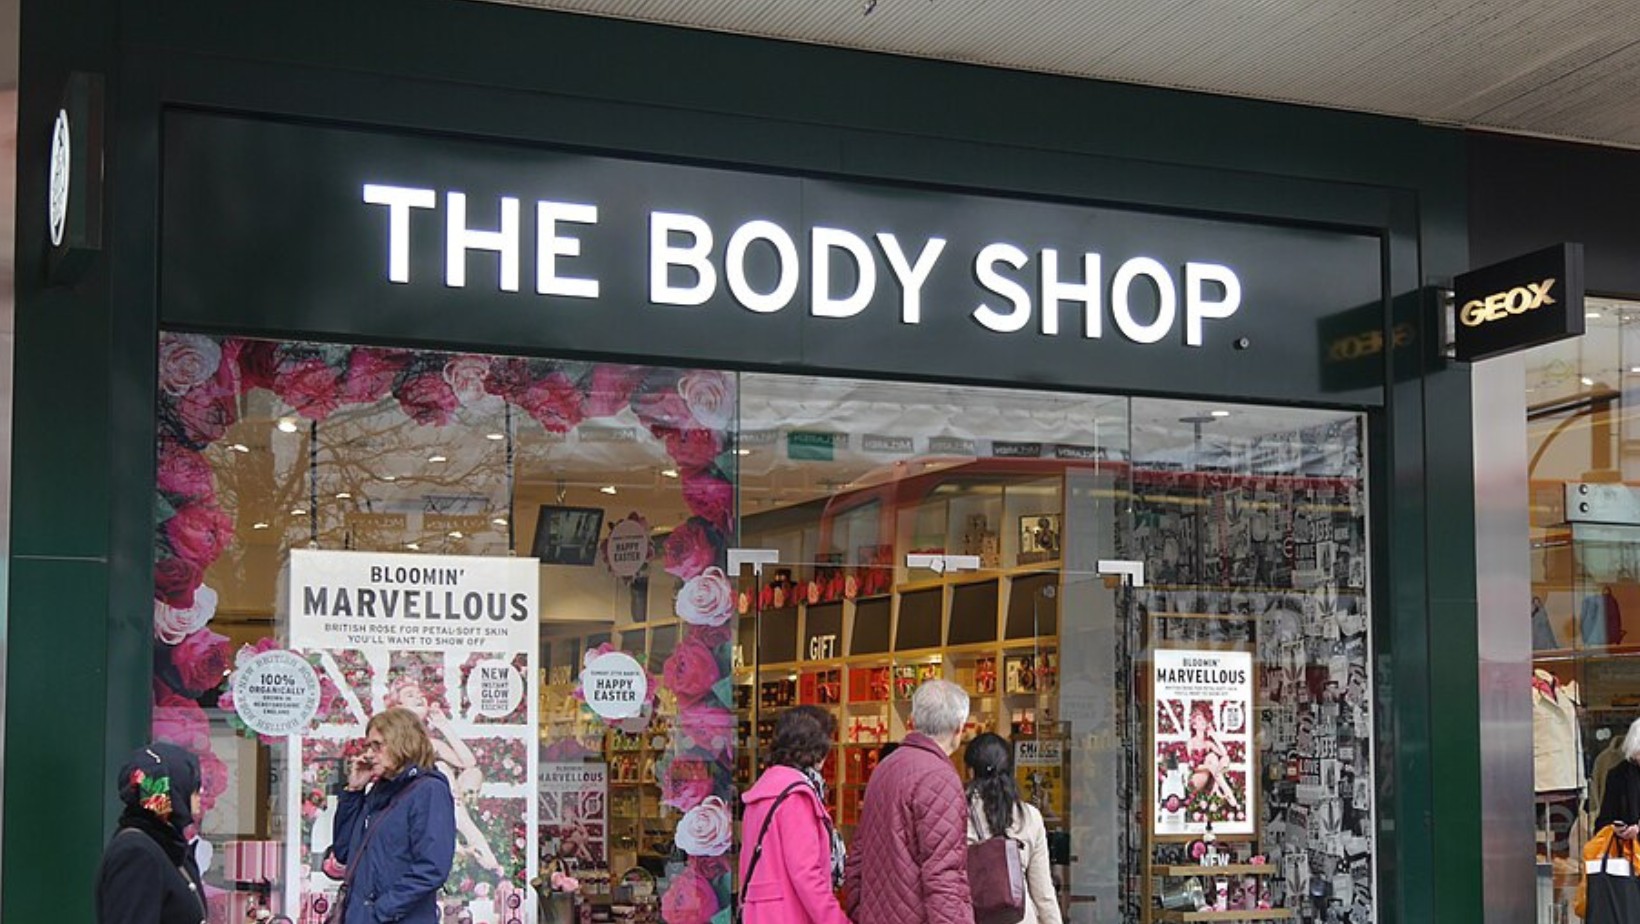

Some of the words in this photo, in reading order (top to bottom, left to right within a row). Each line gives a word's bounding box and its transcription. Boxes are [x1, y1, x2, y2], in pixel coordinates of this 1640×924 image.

[363, 183, 599, 299] THE
[649, 211, 946, 324] BODY
[1460, 278, 1556, 327] GEOX
[616, 542, 639, 551] HAPPY
[614, 551, 640, 562] EASTER
[371, 566, 465, 586] BLOOMIN'
[303, 586, 528, 621] MARVELLOUS
[324, 623, 366, 632] BRITISH
[369, 624, 396, 634] ROSE
[400, 625, 419, 635] FOR
[485, 627, 508, 636] SKIN
[347, 635, 384, 644] YOU'LL
[387, 636, 416, 644] WANT
[420, 637, 432, 645] TO
[435, 637, 463, 645] SHOW
[467, 637, 486, 646] OFF
[810, 635, 836, 660] GIFT
[1183, 658, 1220, 667] BLOOMIN'
[481, 667, 509, 680] NEW
[1157, 668, 1246, 684] MARVELLOUS
[260, 674, 296, 686] 100%
[596, 678, 633, 690] HAPPY
[249, 686, 305, 695] ORGANICALLY
[481, 689, 508, 698] GLOW
[594, 690, 636, 701] EASTER
[1199, 853, 1230, 867] NEW
